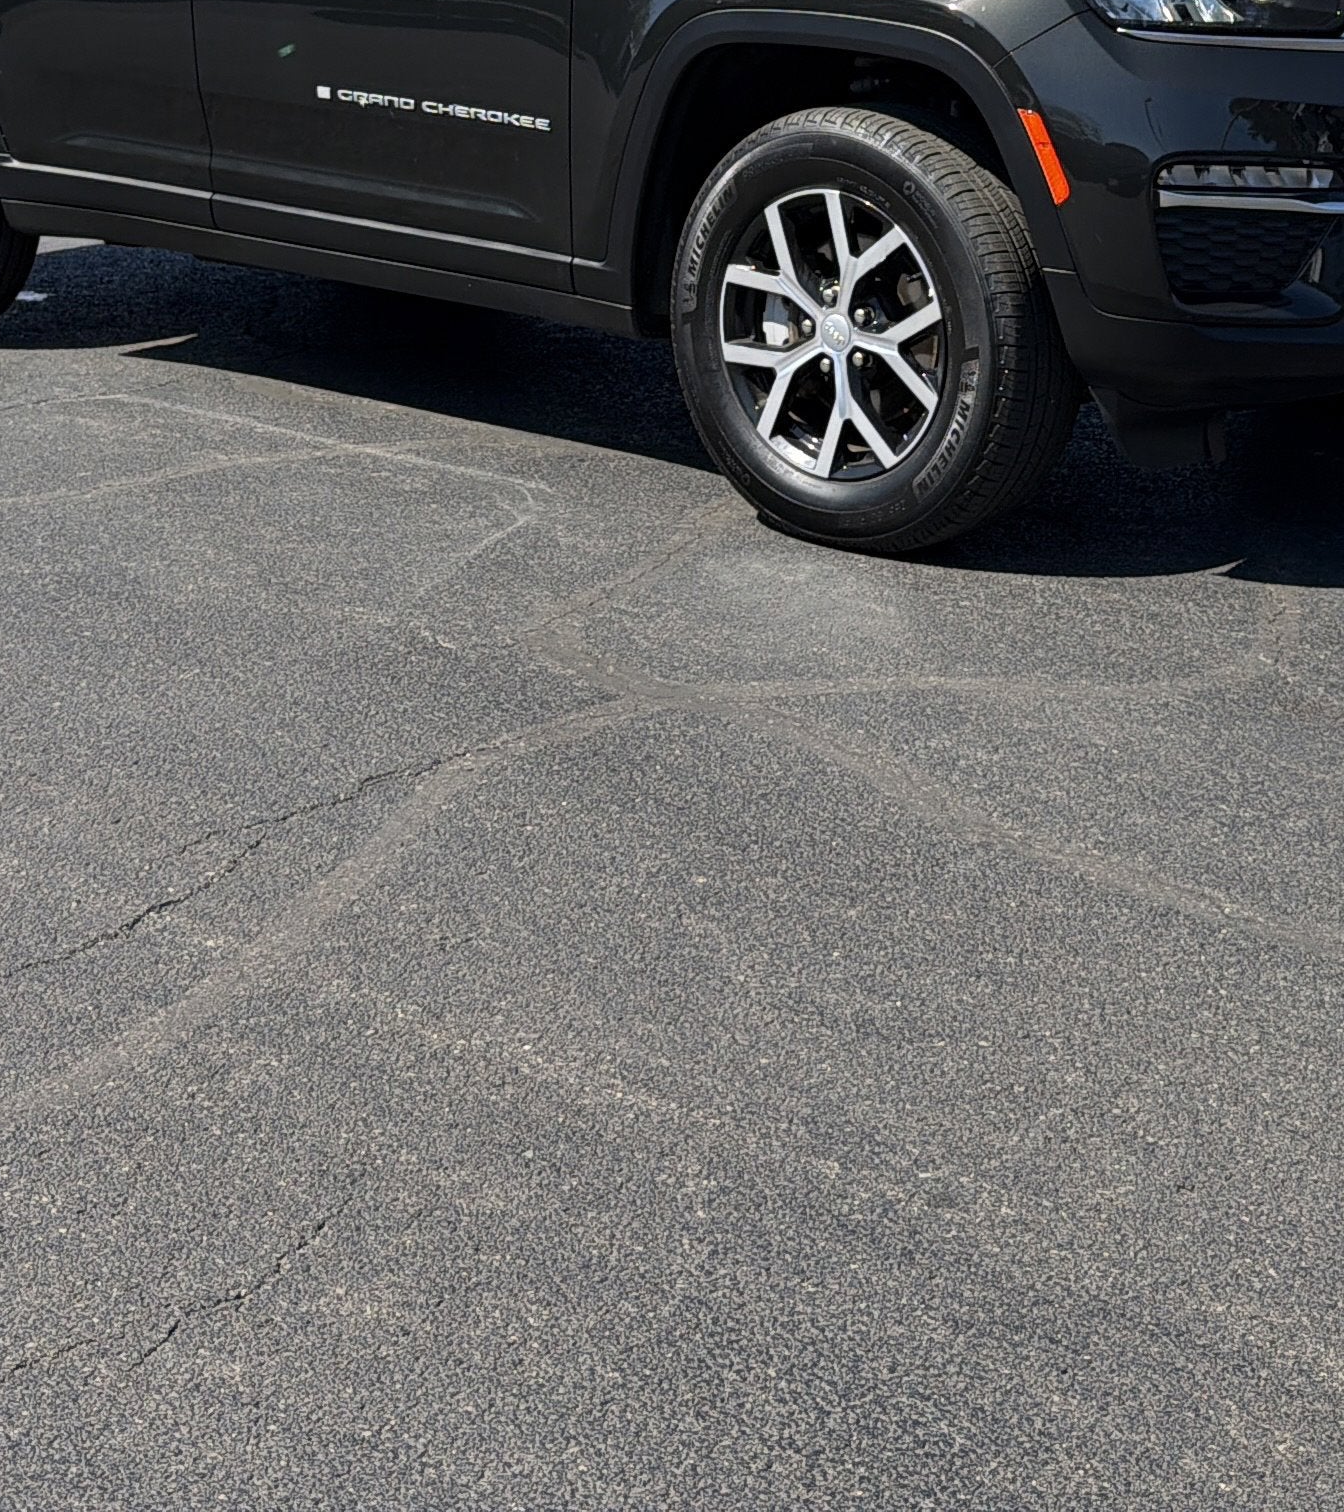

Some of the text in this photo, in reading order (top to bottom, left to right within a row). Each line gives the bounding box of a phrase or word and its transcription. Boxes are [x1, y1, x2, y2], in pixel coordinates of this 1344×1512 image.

[337, 89, 551, 132] GRAND CHEROKEE
[687, 183, 735, 277] MICHELIN
[914, 399, 971, 495] MICHELIN
